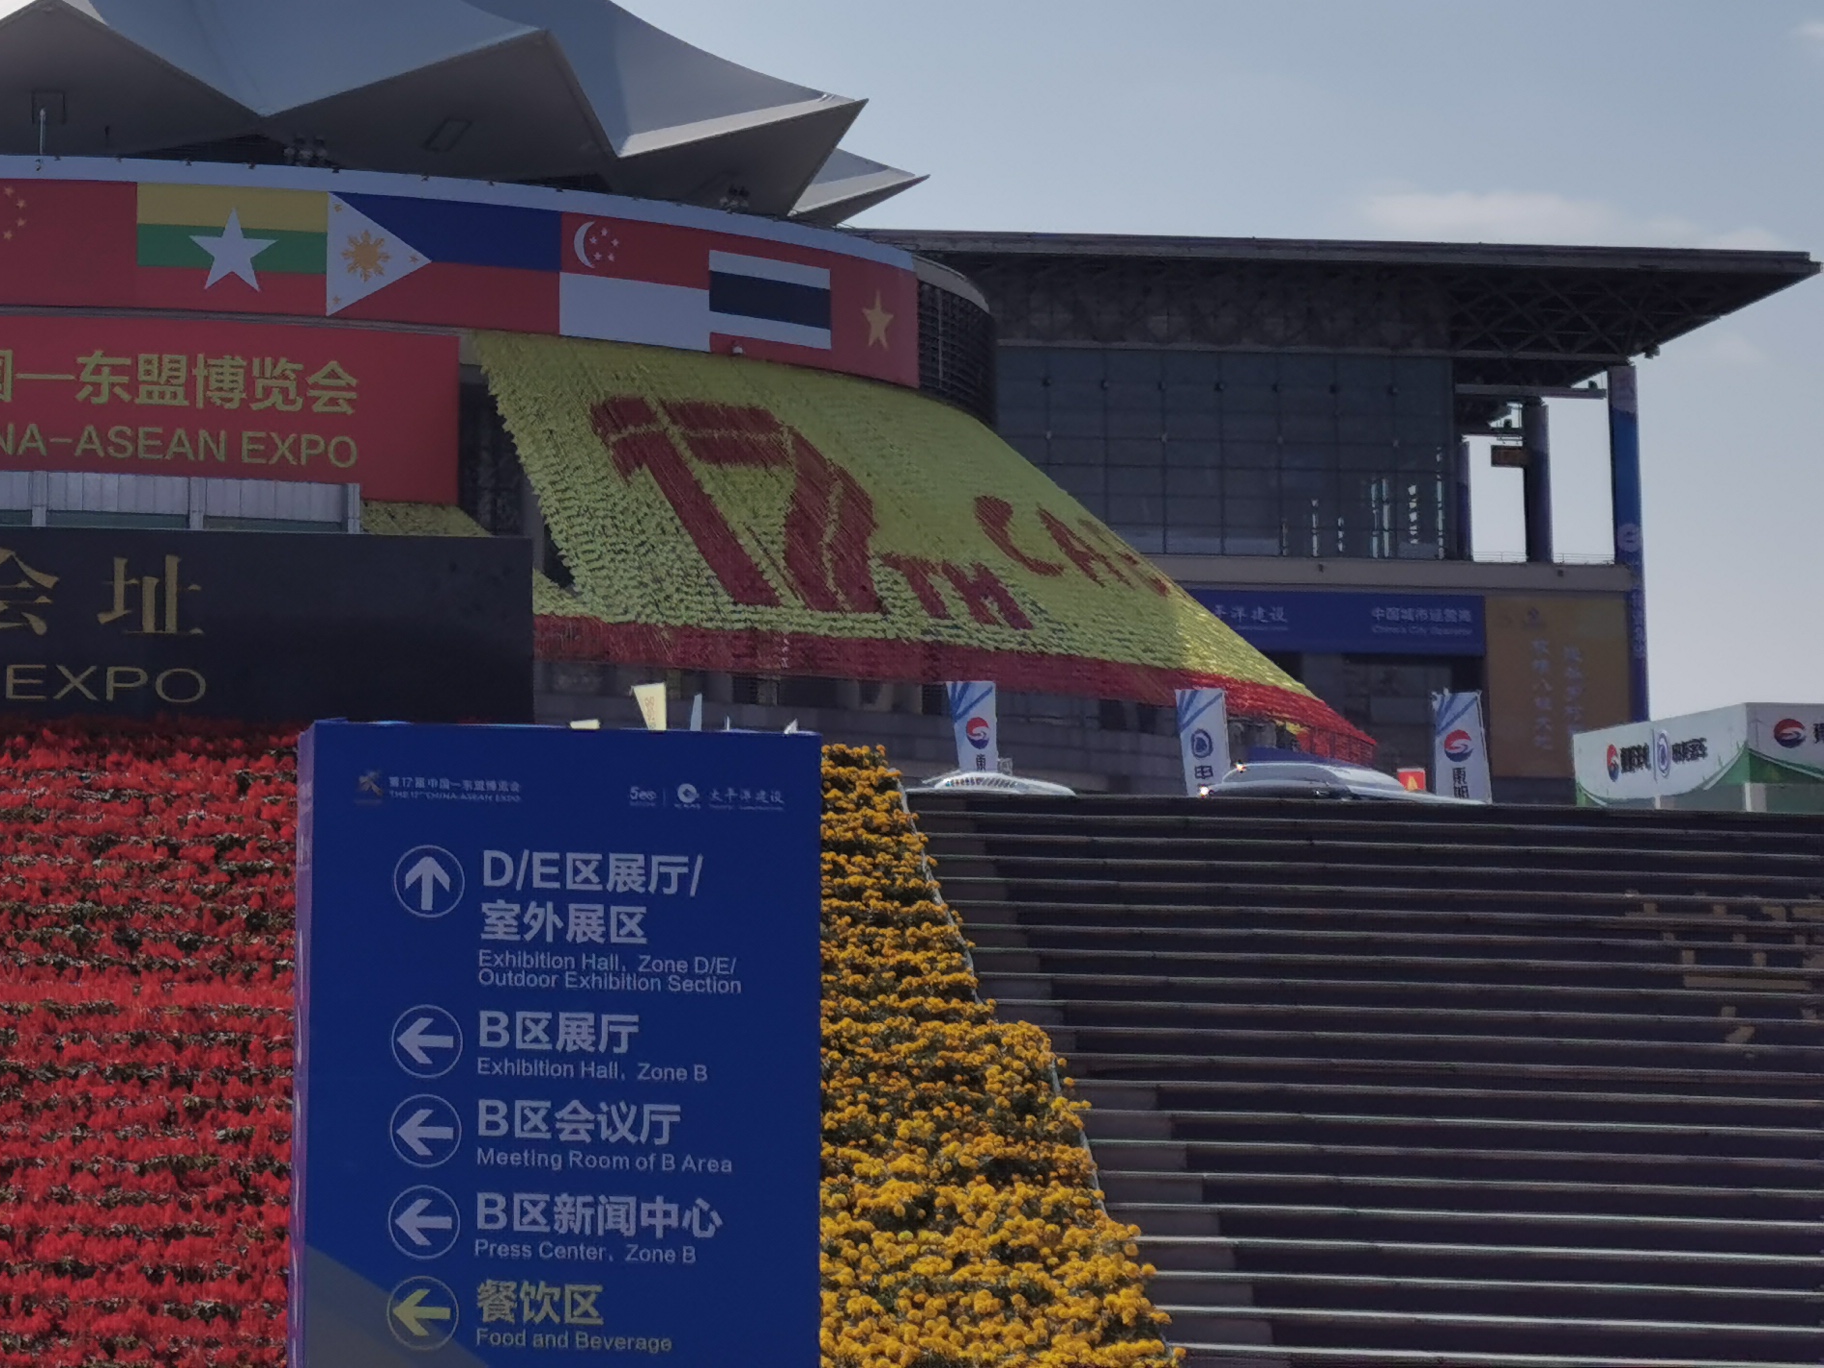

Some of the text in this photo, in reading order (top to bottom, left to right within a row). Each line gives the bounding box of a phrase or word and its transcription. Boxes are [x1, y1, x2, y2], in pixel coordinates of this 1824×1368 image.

[242, 431, 357, 467] EXPO
[6, 665, 206, 702] EXPO
[484, 850, 703, 896] D/E区展厅/
[481, 900, 647, 944] 室外展区
[478, 968, 741, 993] Outdoor Exhibition Section
[479, 949, 575, 970] Exhibition
[638, 955, 688, 975] Zone
[694, 957, 736, 977] D/E/
[479, 1011, 638, 1053] B区展厅
[478, 1057, 574, 1077] Exhibition
[637, 1063, 687, 1081] Zone
[694, 1065, 707, 1081] B
[478, 1099, 680, 1145] B区会议厅
[477, 1148, 732, 1172] Meeting Room of B Area
[476, 1193, 722, 1240] B区新闻中心
[475, 1239, 532, 1257] Press
[625, 1244, 675, 1263] Zone
[683, 1246, 695, 1263] B
[477, 1279, 603, 1324] 餐饮区
[477, 1328, 672, 1353] Food and Beverage
